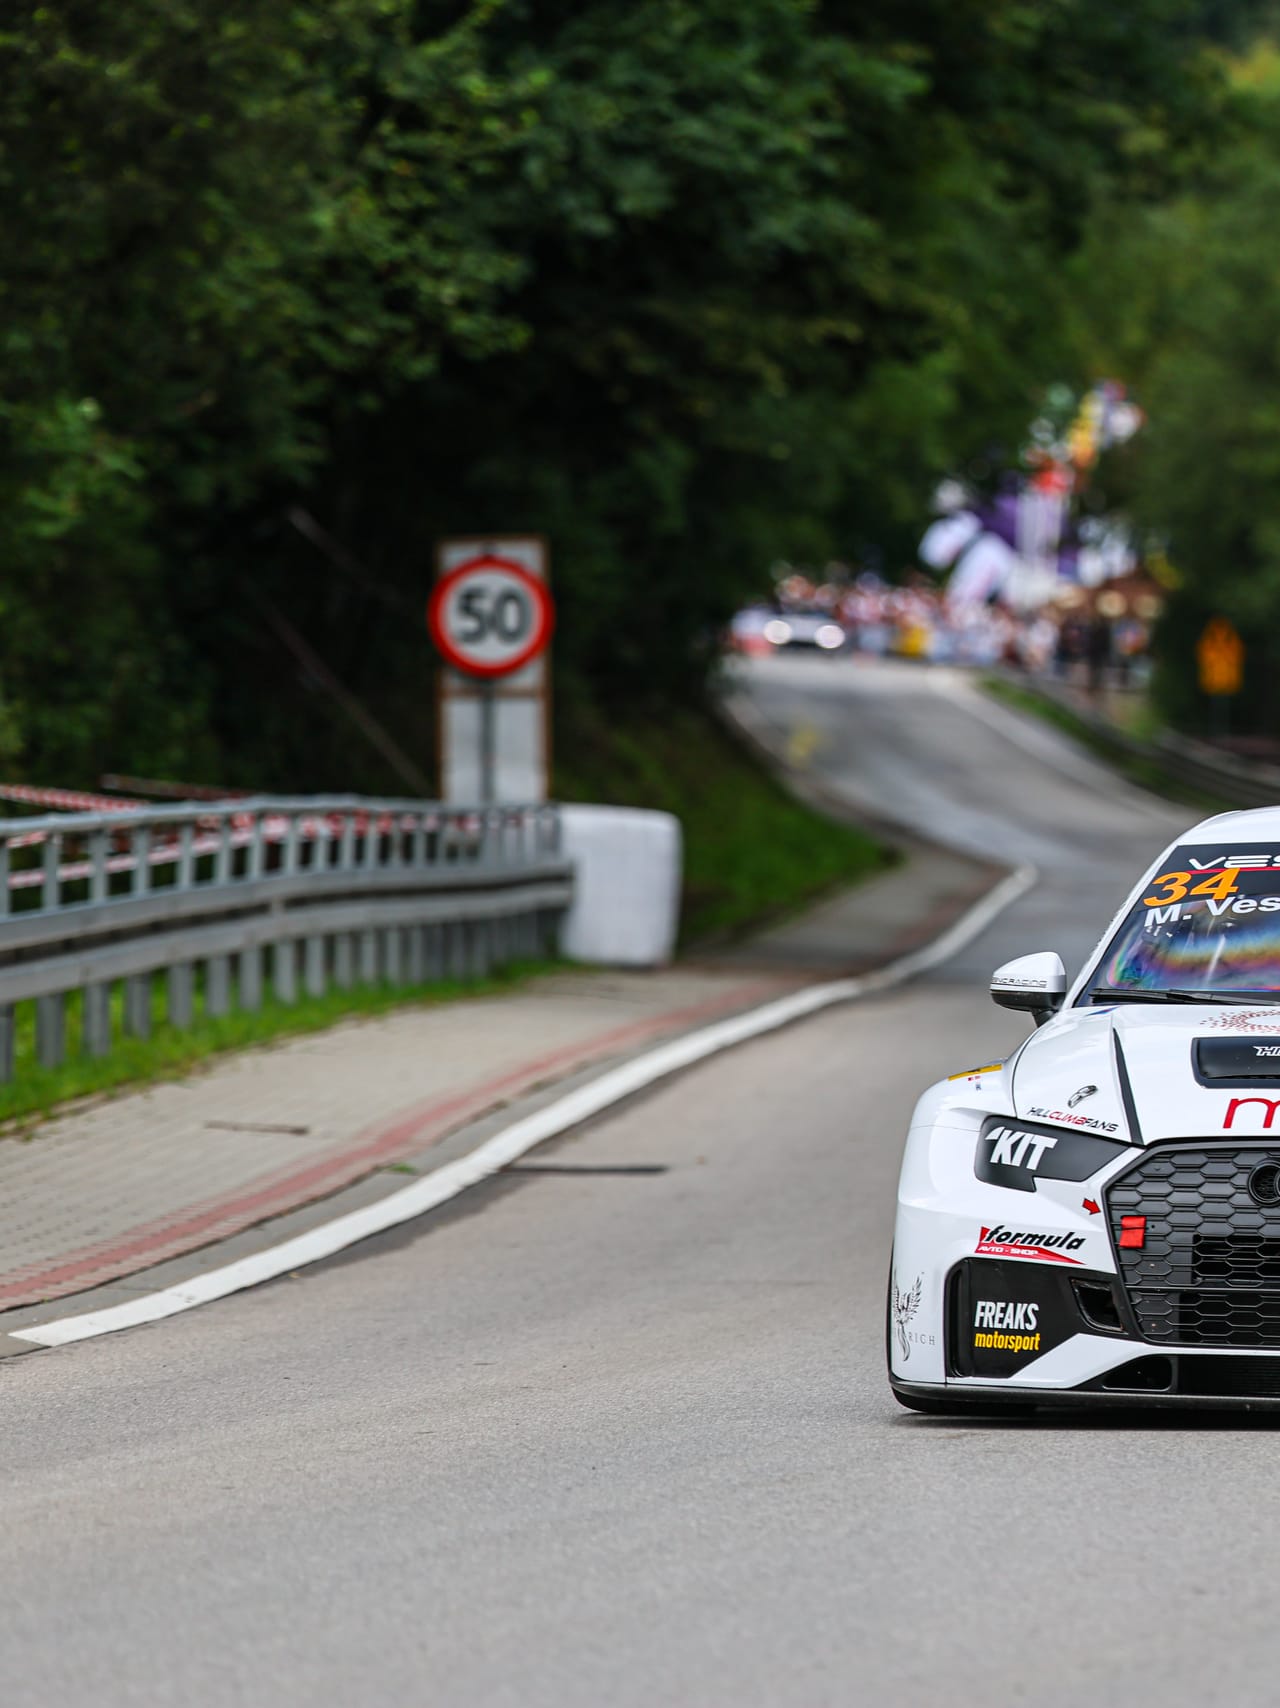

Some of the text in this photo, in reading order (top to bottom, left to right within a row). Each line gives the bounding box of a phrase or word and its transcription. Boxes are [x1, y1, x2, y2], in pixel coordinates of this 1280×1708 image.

[457, 585, 532, 646] 50
[1144, 868, 1240, 907] 34
[1144, 904, 1192, 927] M.
[1029, 1106, 1119, 1133] HILLCLIMBFANS
[990, 1126, 1058, 1171] KIT
[983, 1224, 1087, 1251] formula
[974, 1300, 1039, 1331] FREAKS
[975, 1332, 1041, 1352] motorsport
